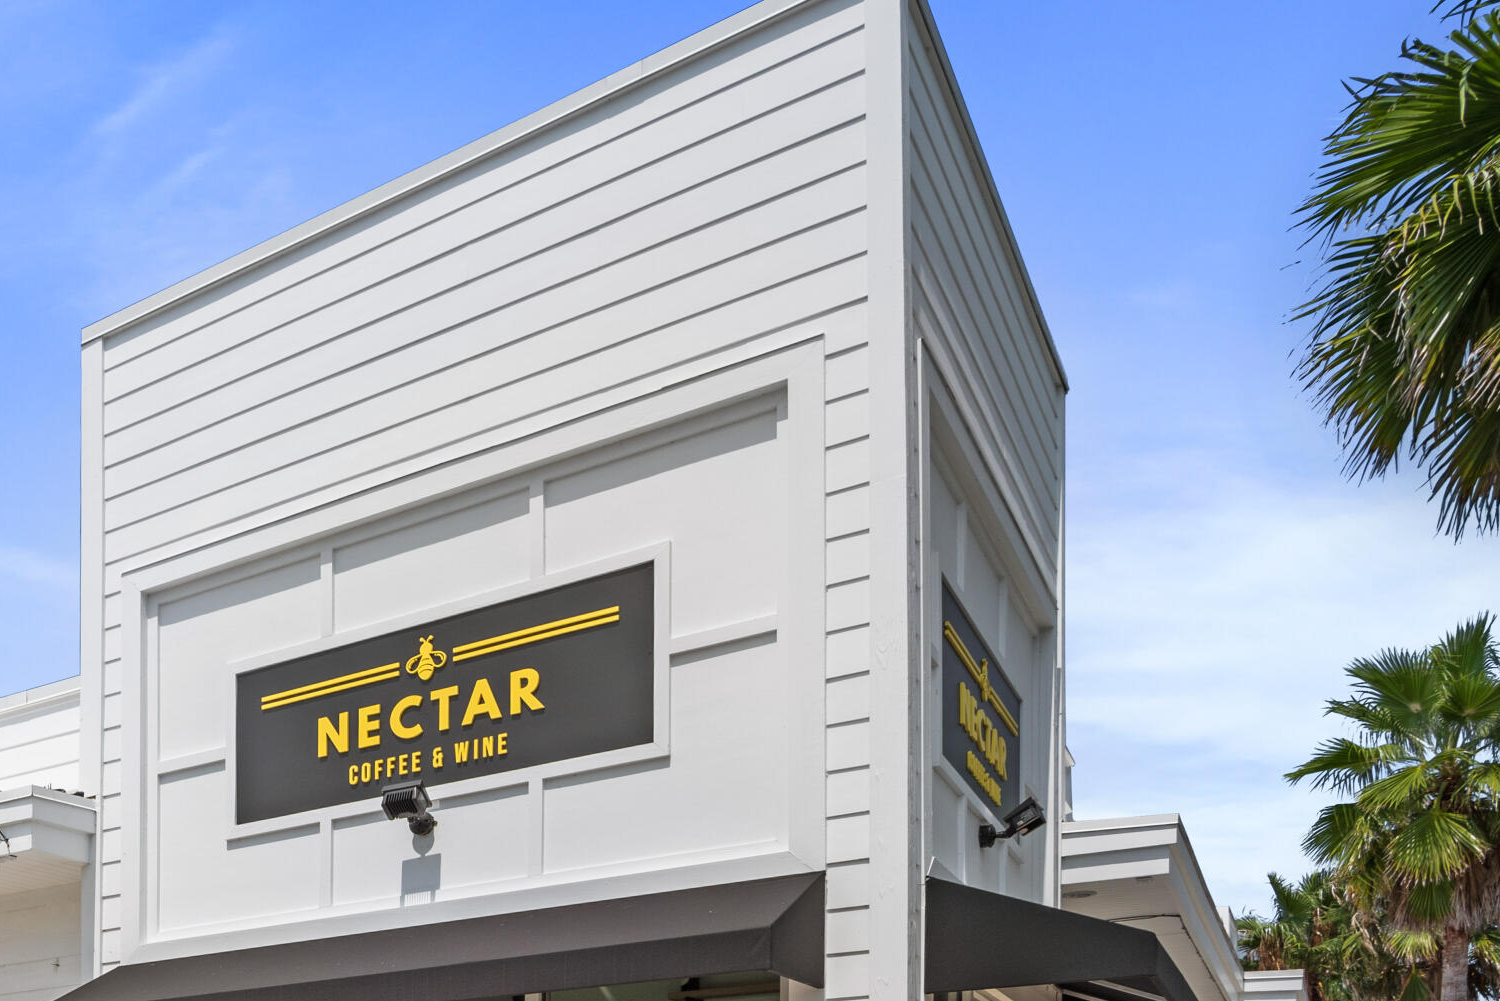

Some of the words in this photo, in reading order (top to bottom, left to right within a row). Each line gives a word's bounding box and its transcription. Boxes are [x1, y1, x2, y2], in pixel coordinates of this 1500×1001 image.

[317, 667, 545, 759] NECTAR
[348, 749, 422, 786] COFFEE
[431, 747, 444, 769] &
[454, 732, 510, 763] WINE
[959, 681, 1008, 782] NECTAR
